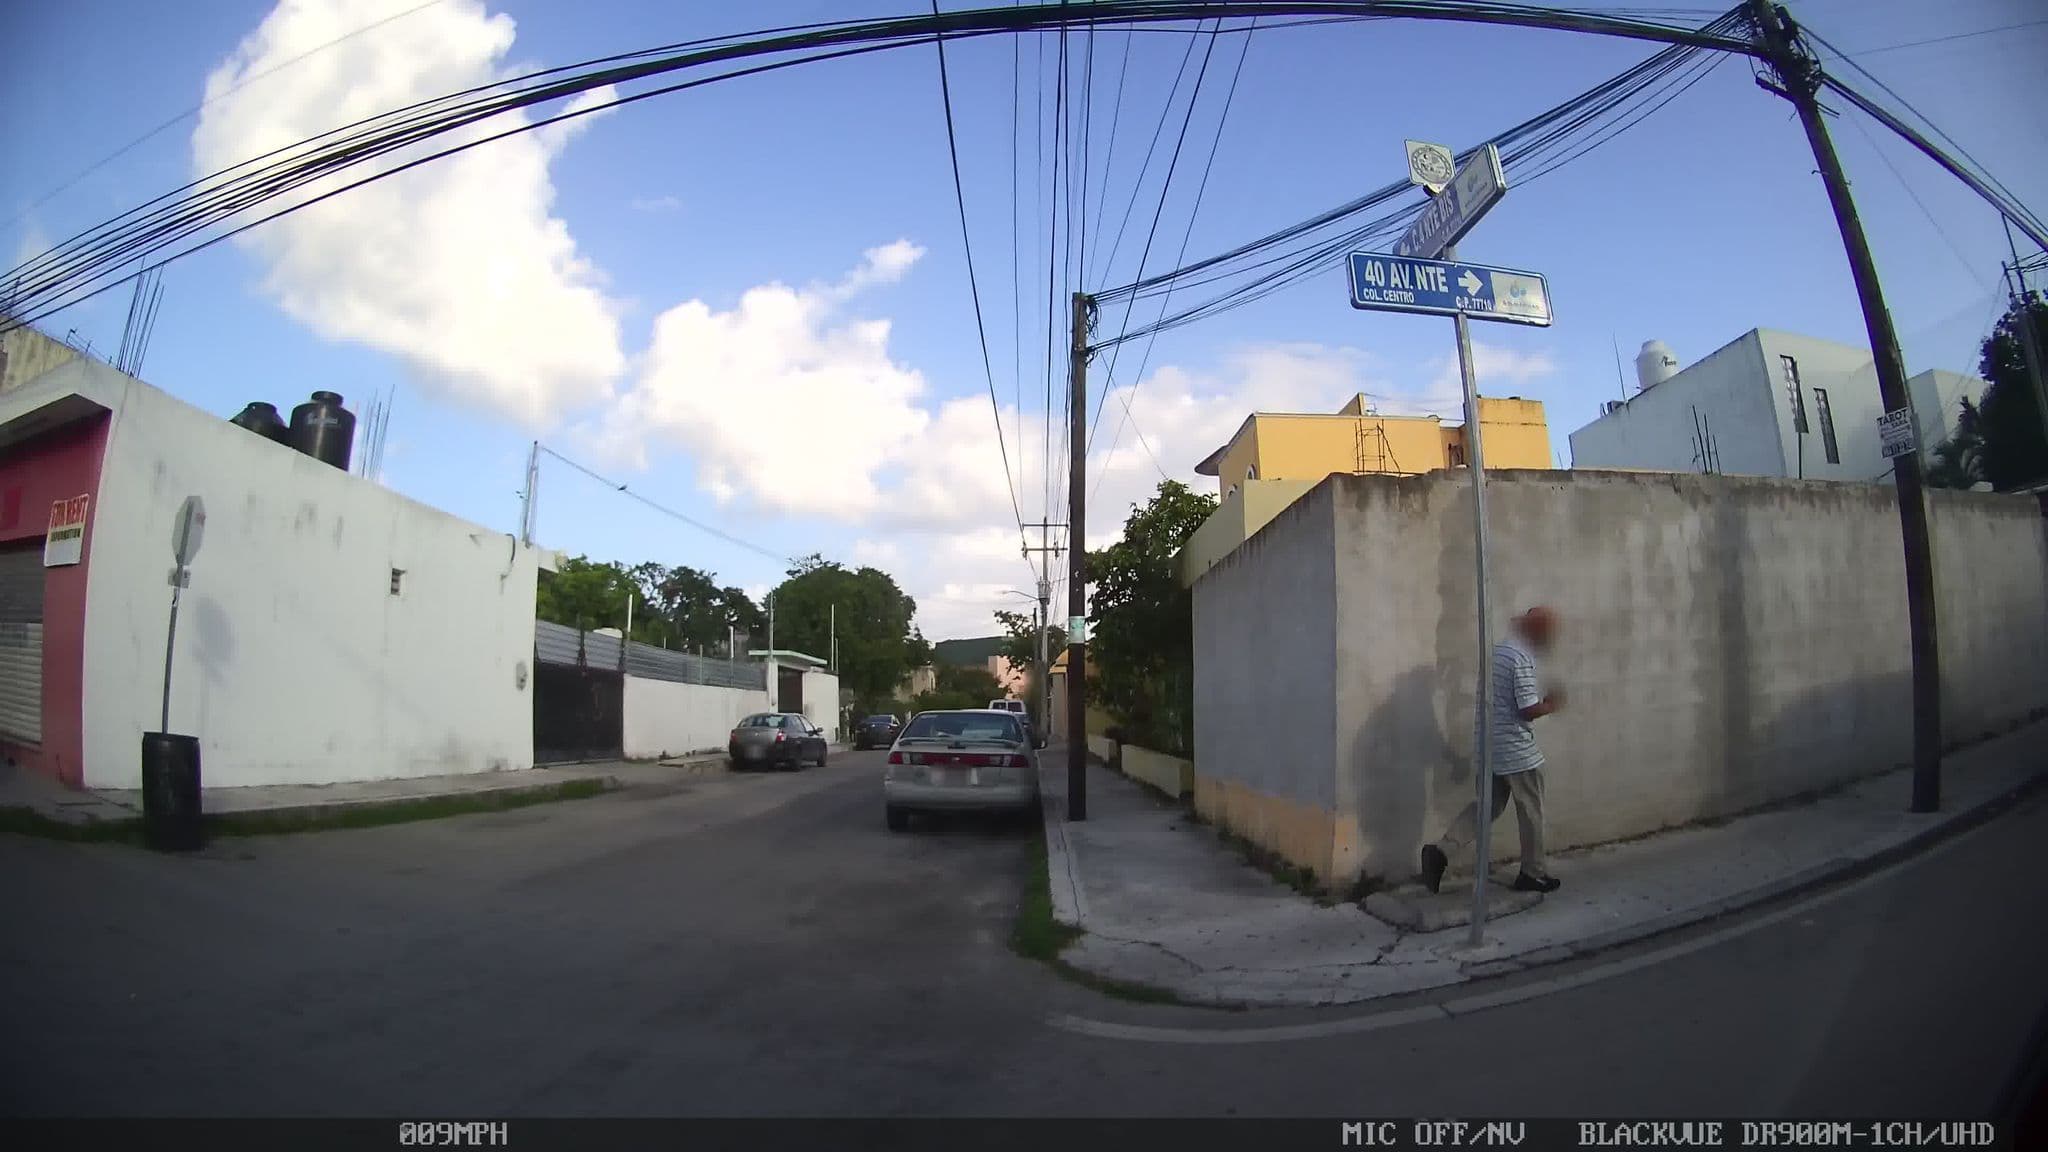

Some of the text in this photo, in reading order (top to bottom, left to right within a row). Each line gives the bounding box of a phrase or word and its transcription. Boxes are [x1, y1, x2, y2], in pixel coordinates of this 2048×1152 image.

[1365, 260, 1448, 293] 40 AV. NTE
[1363, 287, 1415, 304] COL. CENTRO
[1472, 297, 1493, 311] 77710
[1876, 409, 1907, 426] TAROT
[50, 495, 88, 528] FOR RENT
